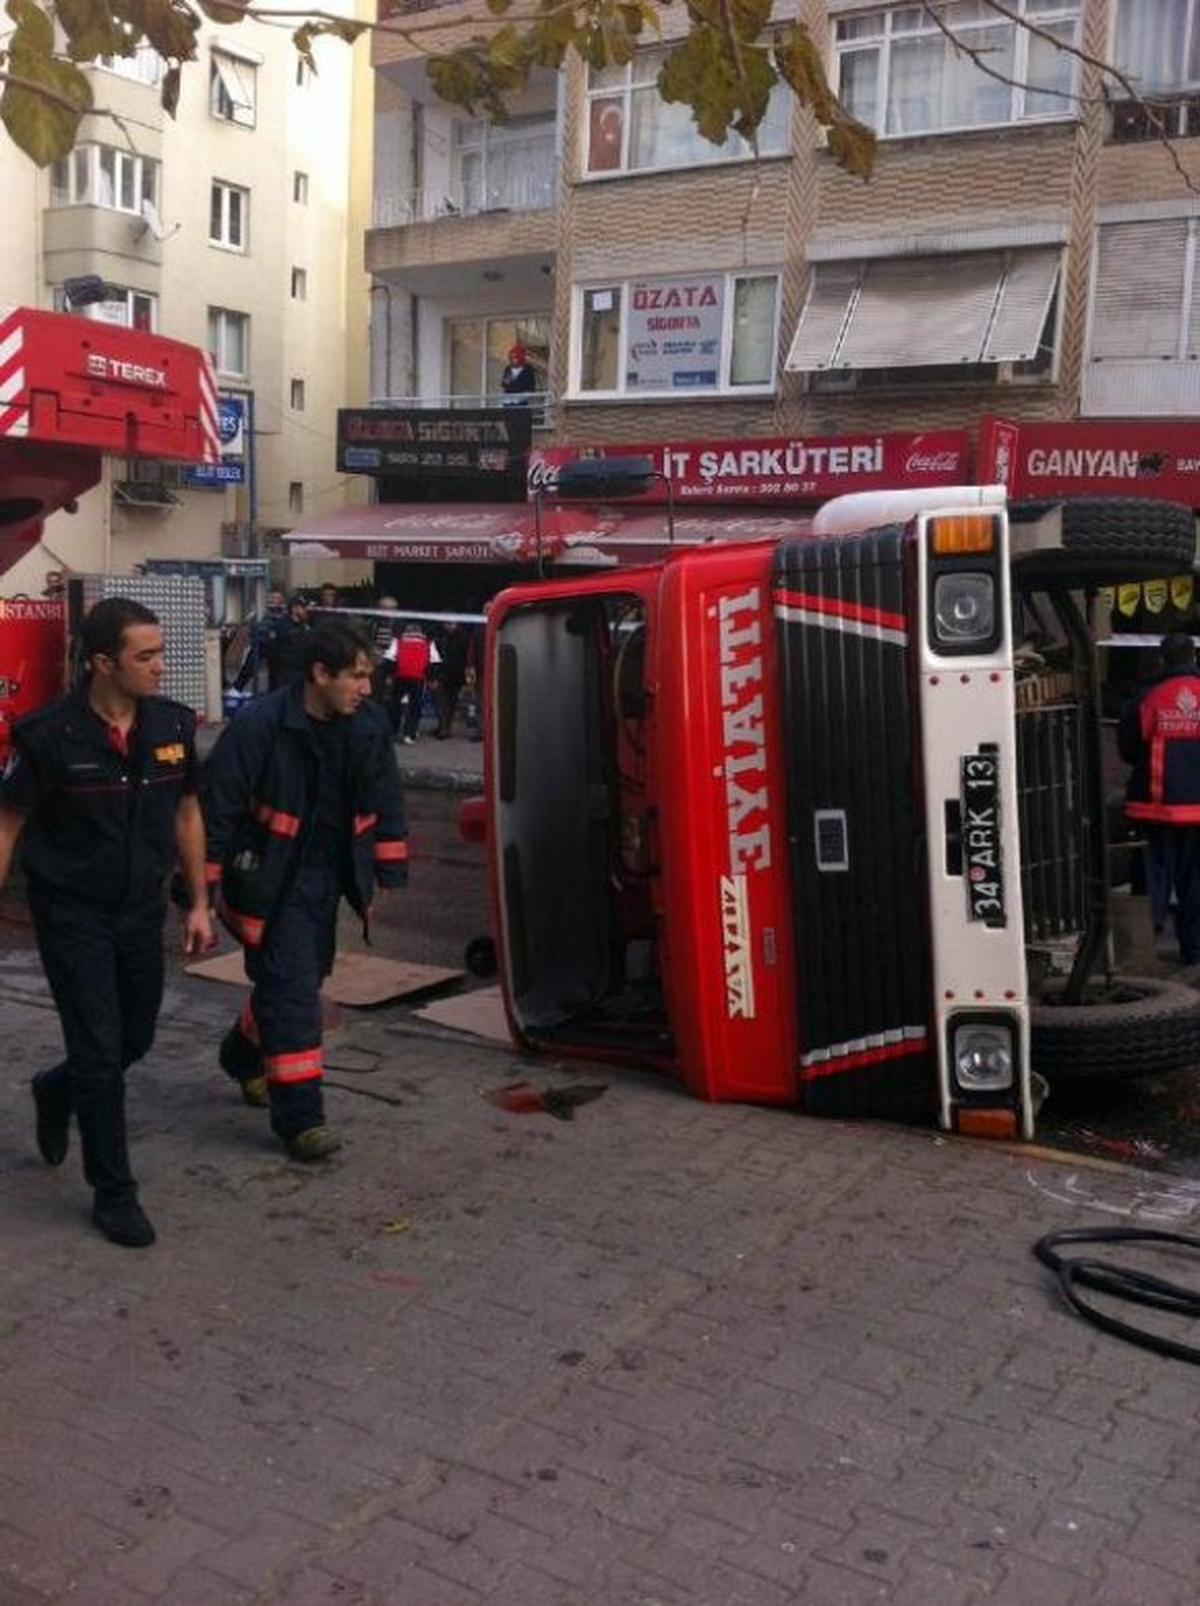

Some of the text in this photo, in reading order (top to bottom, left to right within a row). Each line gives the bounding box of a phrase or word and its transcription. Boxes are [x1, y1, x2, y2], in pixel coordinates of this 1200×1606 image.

[632, 285, 718, 311] ÖZATA
[109, 359, 167, 386] TEREX
[699, 438, 884, 483] ŞARKÜTERİ
[1027, 448, 1139, 477] GANYAN
[393, 544, 439, 558] MARKET
[966, 760, 1001, 915] 34 ARK 13
